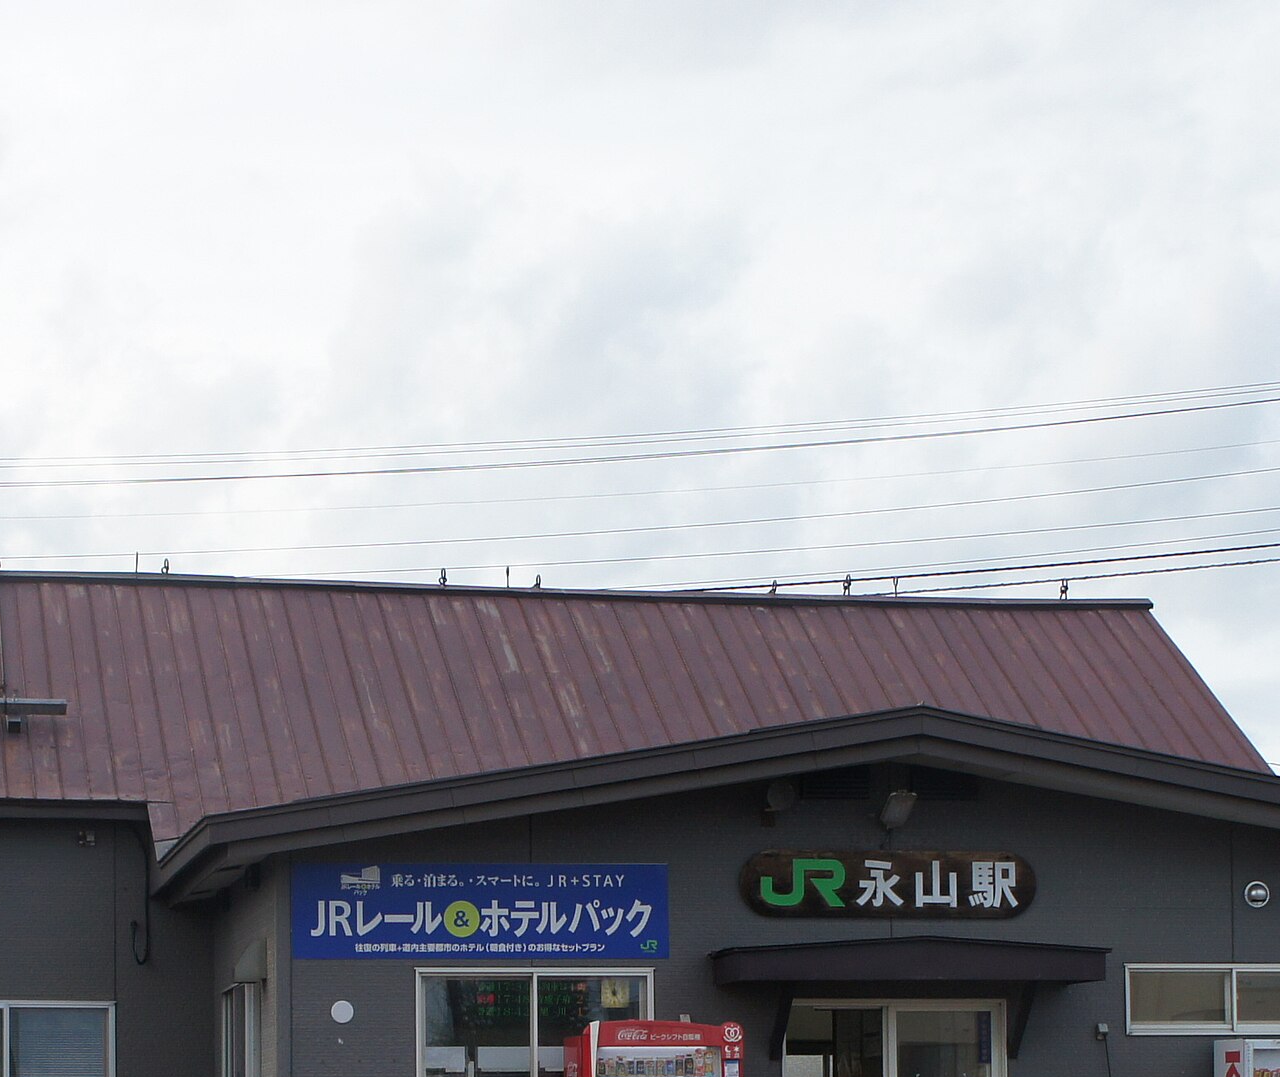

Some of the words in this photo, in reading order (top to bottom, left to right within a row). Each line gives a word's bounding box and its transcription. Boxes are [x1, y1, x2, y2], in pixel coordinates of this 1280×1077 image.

[760, 858, 846, 907] JR
[856, 859, 1020, 908] 永山駅
[310, 899, 653, 938] JRレール&ホテルパック
